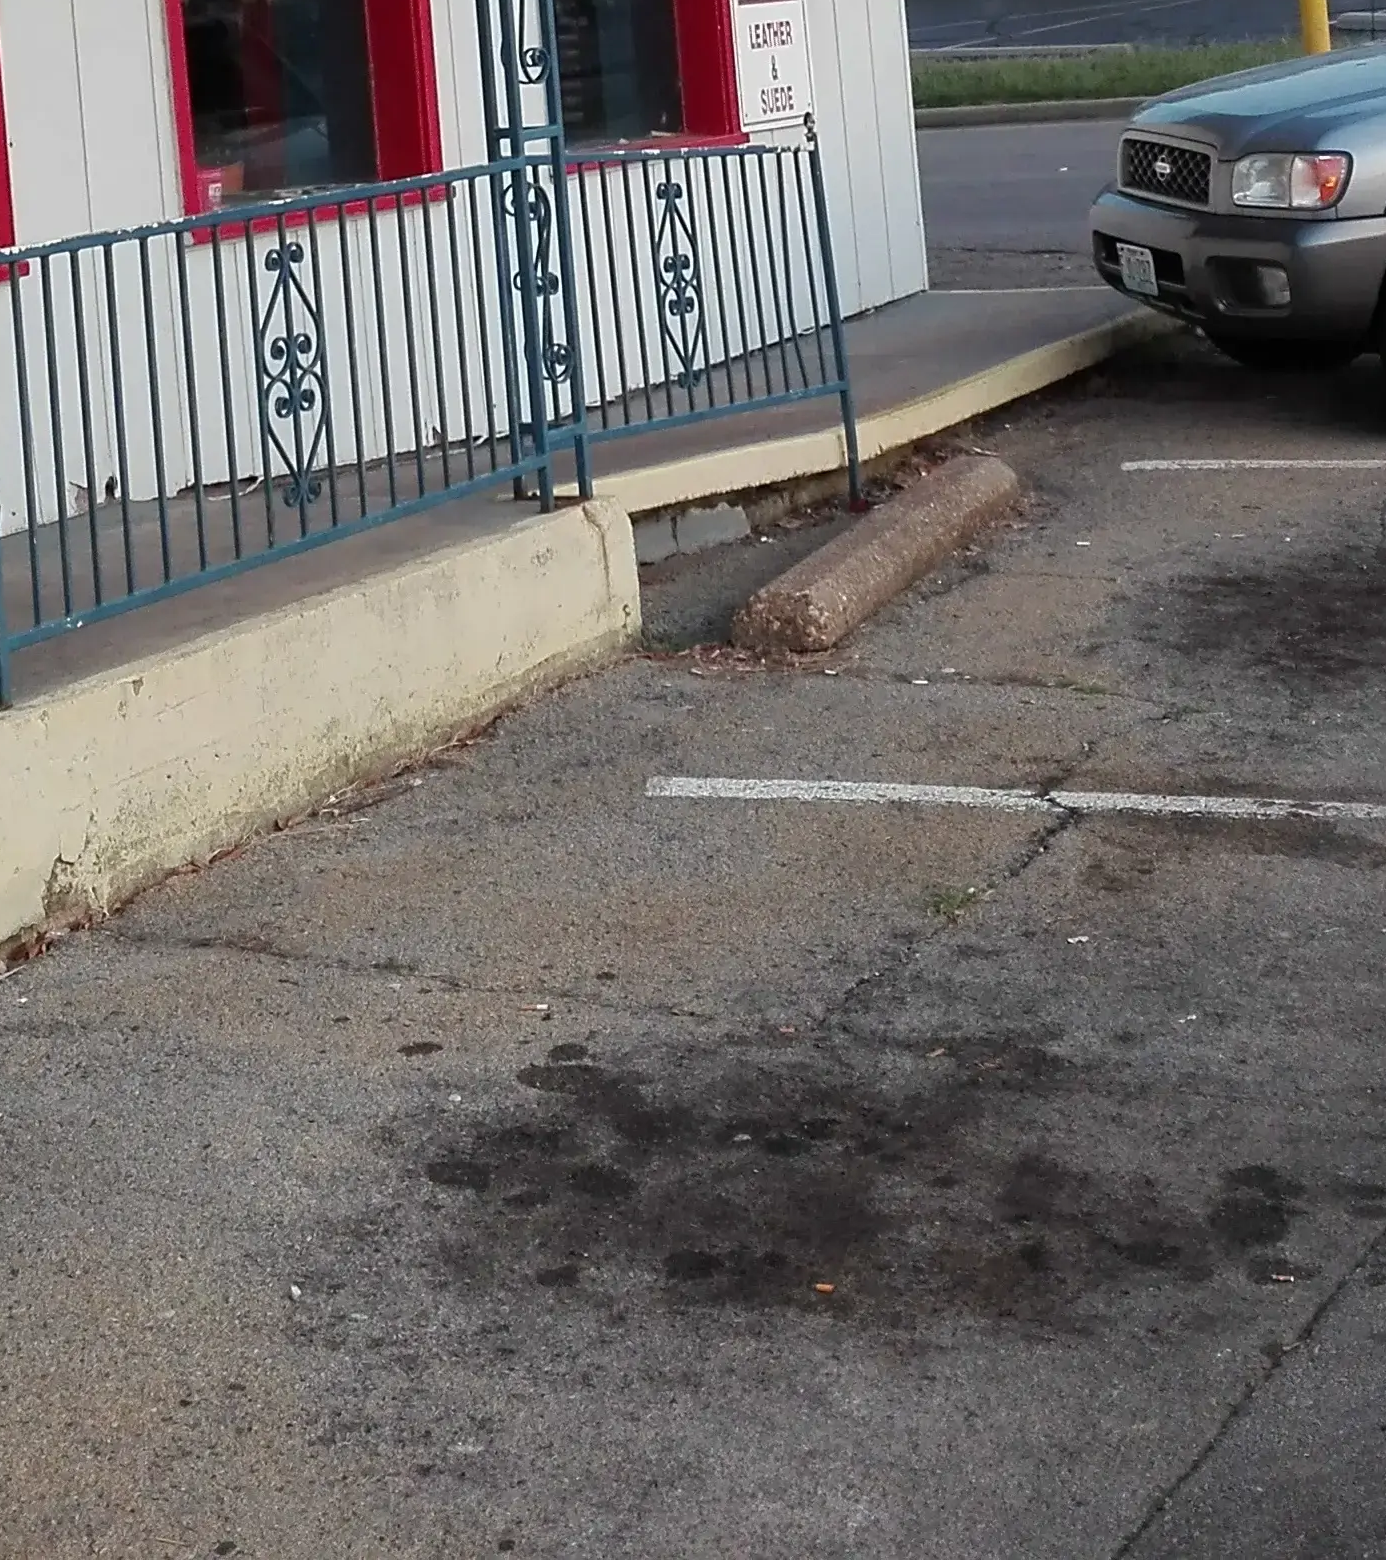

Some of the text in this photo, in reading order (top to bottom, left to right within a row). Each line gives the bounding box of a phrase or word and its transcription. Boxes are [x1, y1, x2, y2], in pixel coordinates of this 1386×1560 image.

[749, 21, 793, 50] LEATHER
[770, 55, 778, 80] &
[761, 85, 794, 116] SUEDE
